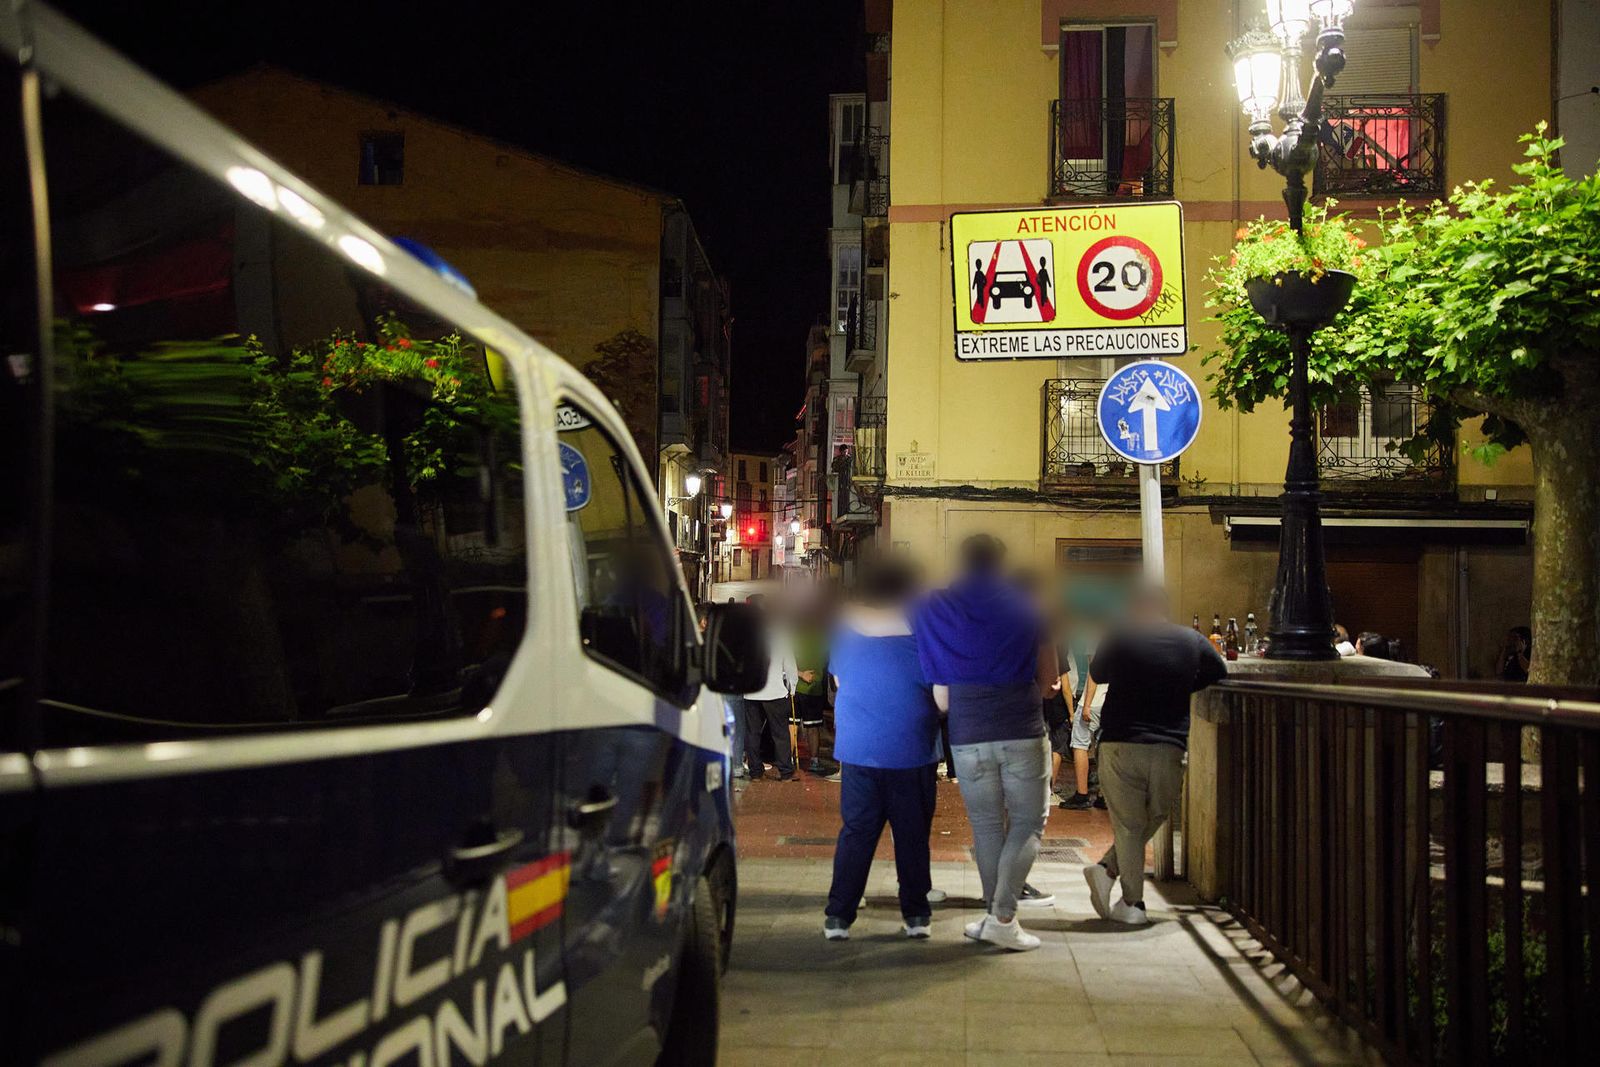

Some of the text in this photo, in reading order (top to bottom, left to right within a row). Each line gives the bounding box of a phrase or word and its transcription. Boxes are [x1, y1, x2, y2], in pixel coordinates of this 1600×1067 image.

[1017, 210, 1116, 233] ATENCIÓN
[1092, 260, 1147, 292] 20
[962, 332, 1180, 354] EXTREME LAS PRECAUCIONES
